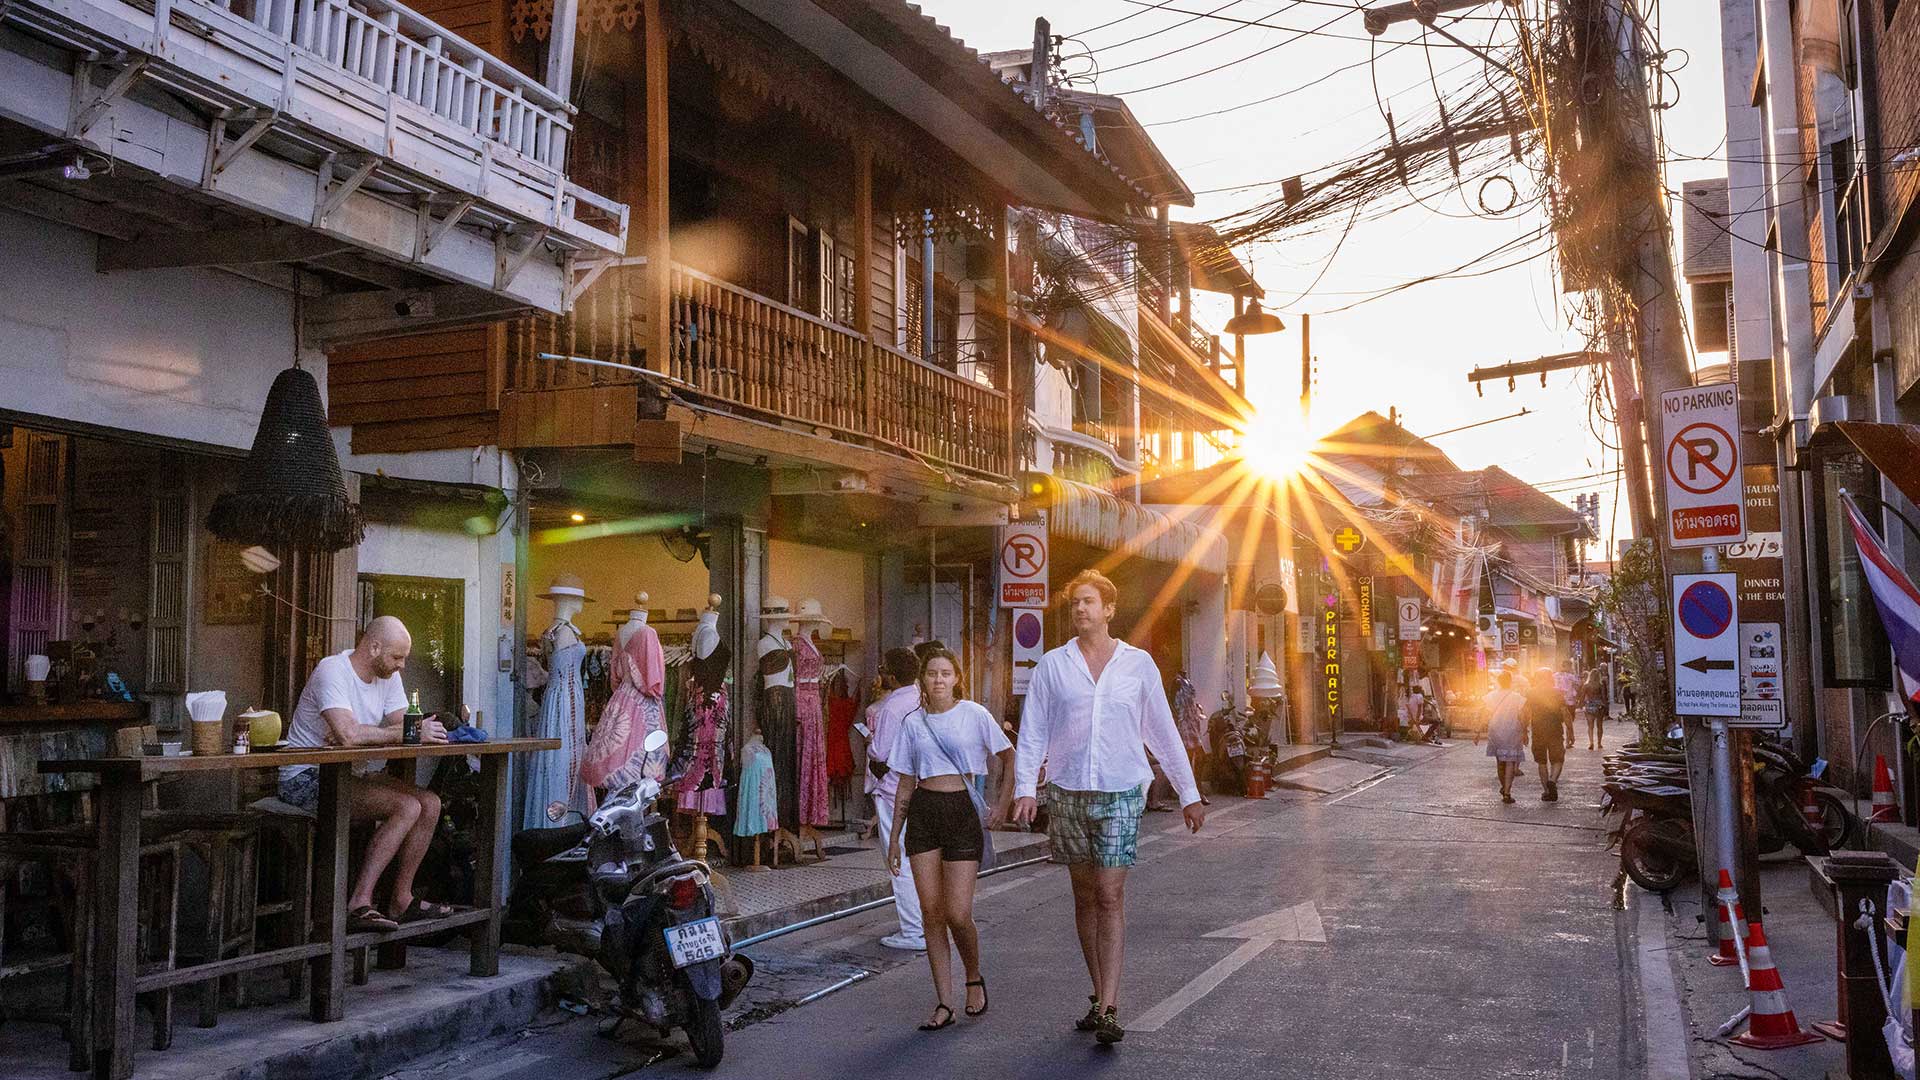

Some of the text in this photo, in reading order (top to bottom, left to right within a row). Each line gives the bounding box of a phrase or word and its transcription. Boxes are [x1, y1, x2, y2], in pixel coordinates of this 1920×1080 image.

[1664, 390, 1733, 413] NO PARKING
[1675, 511, 1738, 531] ห้ามจอดรถ
[1004, 586, 1044, 598] ห้ามจอดรถ
[1744, 579, 1780, 588] DINNER
[1745, 592, 1762, 601] THE
[1361, 585, 1371, 636] EXCHANGE
[1325, 611, 1340, 715] PHARMACY
[684, 946, 714, 961] 545
